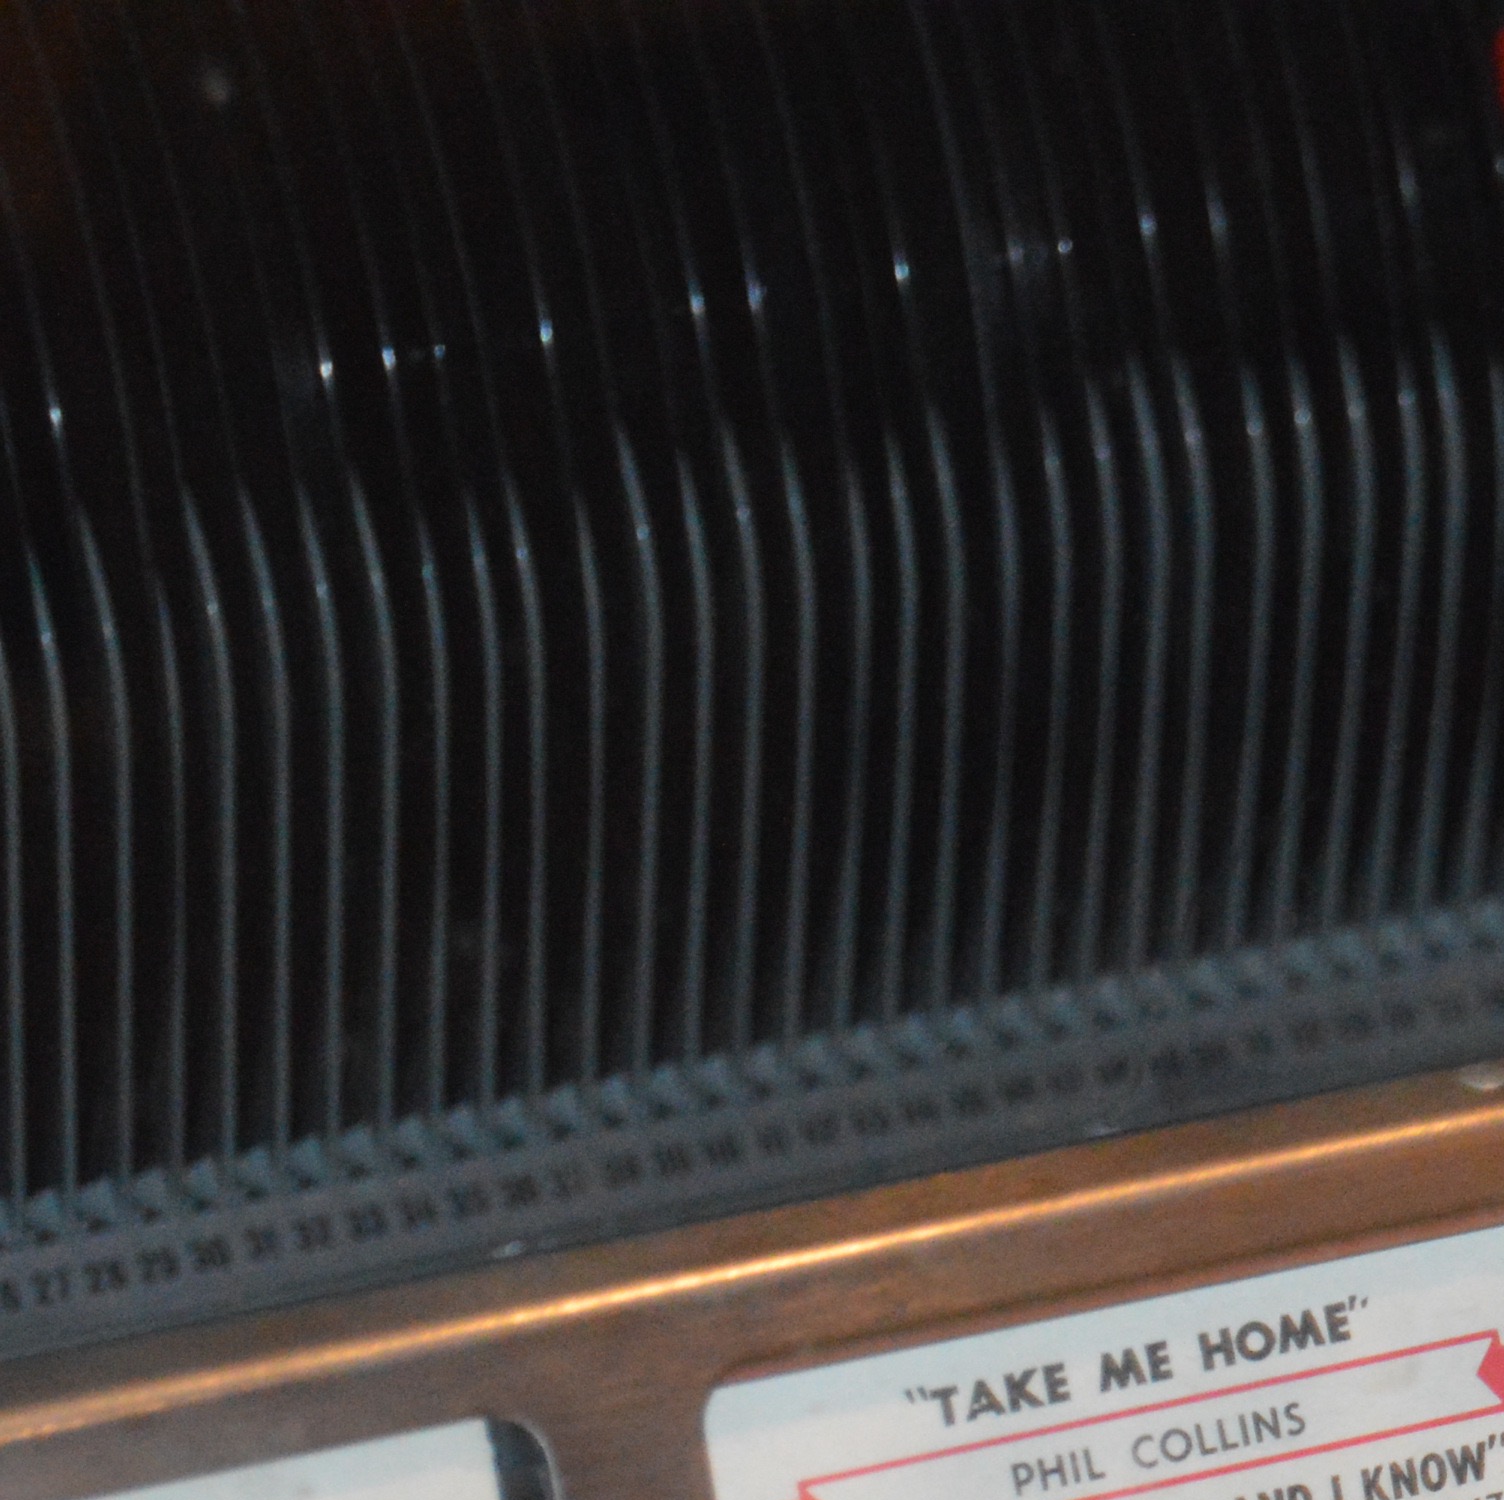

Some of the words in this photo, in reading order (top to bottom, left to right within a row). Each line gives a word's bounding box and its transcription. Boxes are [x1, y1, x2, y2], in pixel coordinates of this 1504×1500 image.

[905, 1366, 1069, 1428] "TAKE
[1099, 1341, 1174, 1394] ME
[1200, 1295, 1371, 1372] HOME"
[1012, 1444, 1105, 1497] PHIL
[1133, 1403, 1307, 1469] COLLINS
